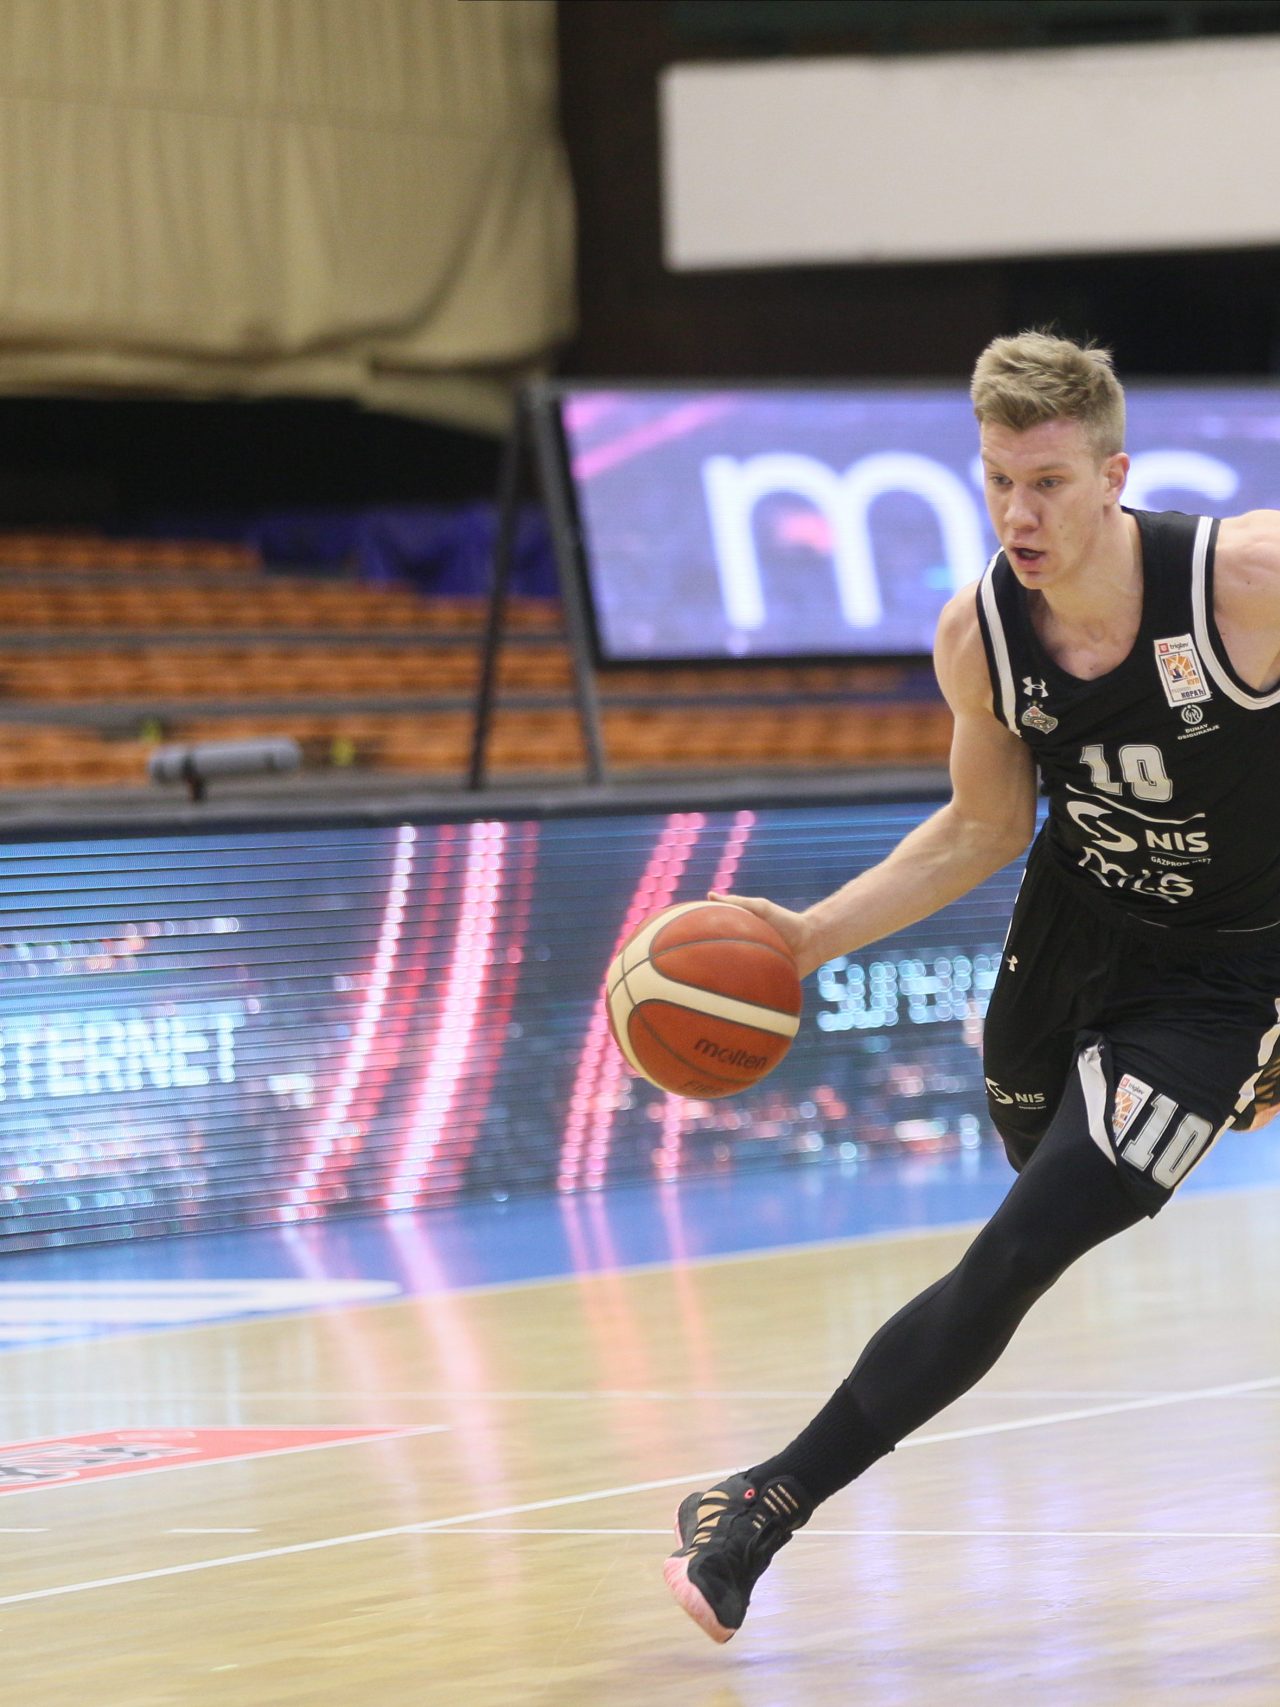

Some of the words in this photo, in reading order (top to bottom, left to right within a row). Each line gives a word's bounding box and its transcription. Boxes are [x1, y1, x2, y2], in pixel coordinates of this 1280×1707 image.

[1080, 744, 1173, 802] 10
[1145, 829, 1209, 853] NIS
[0, 1003, 246, 1099] TERNET
[694, 1038, 768, 1071] molten
[1015, 1092, 1046, 1103] NIS
[1121, 1093, 1214, 1189] 10
